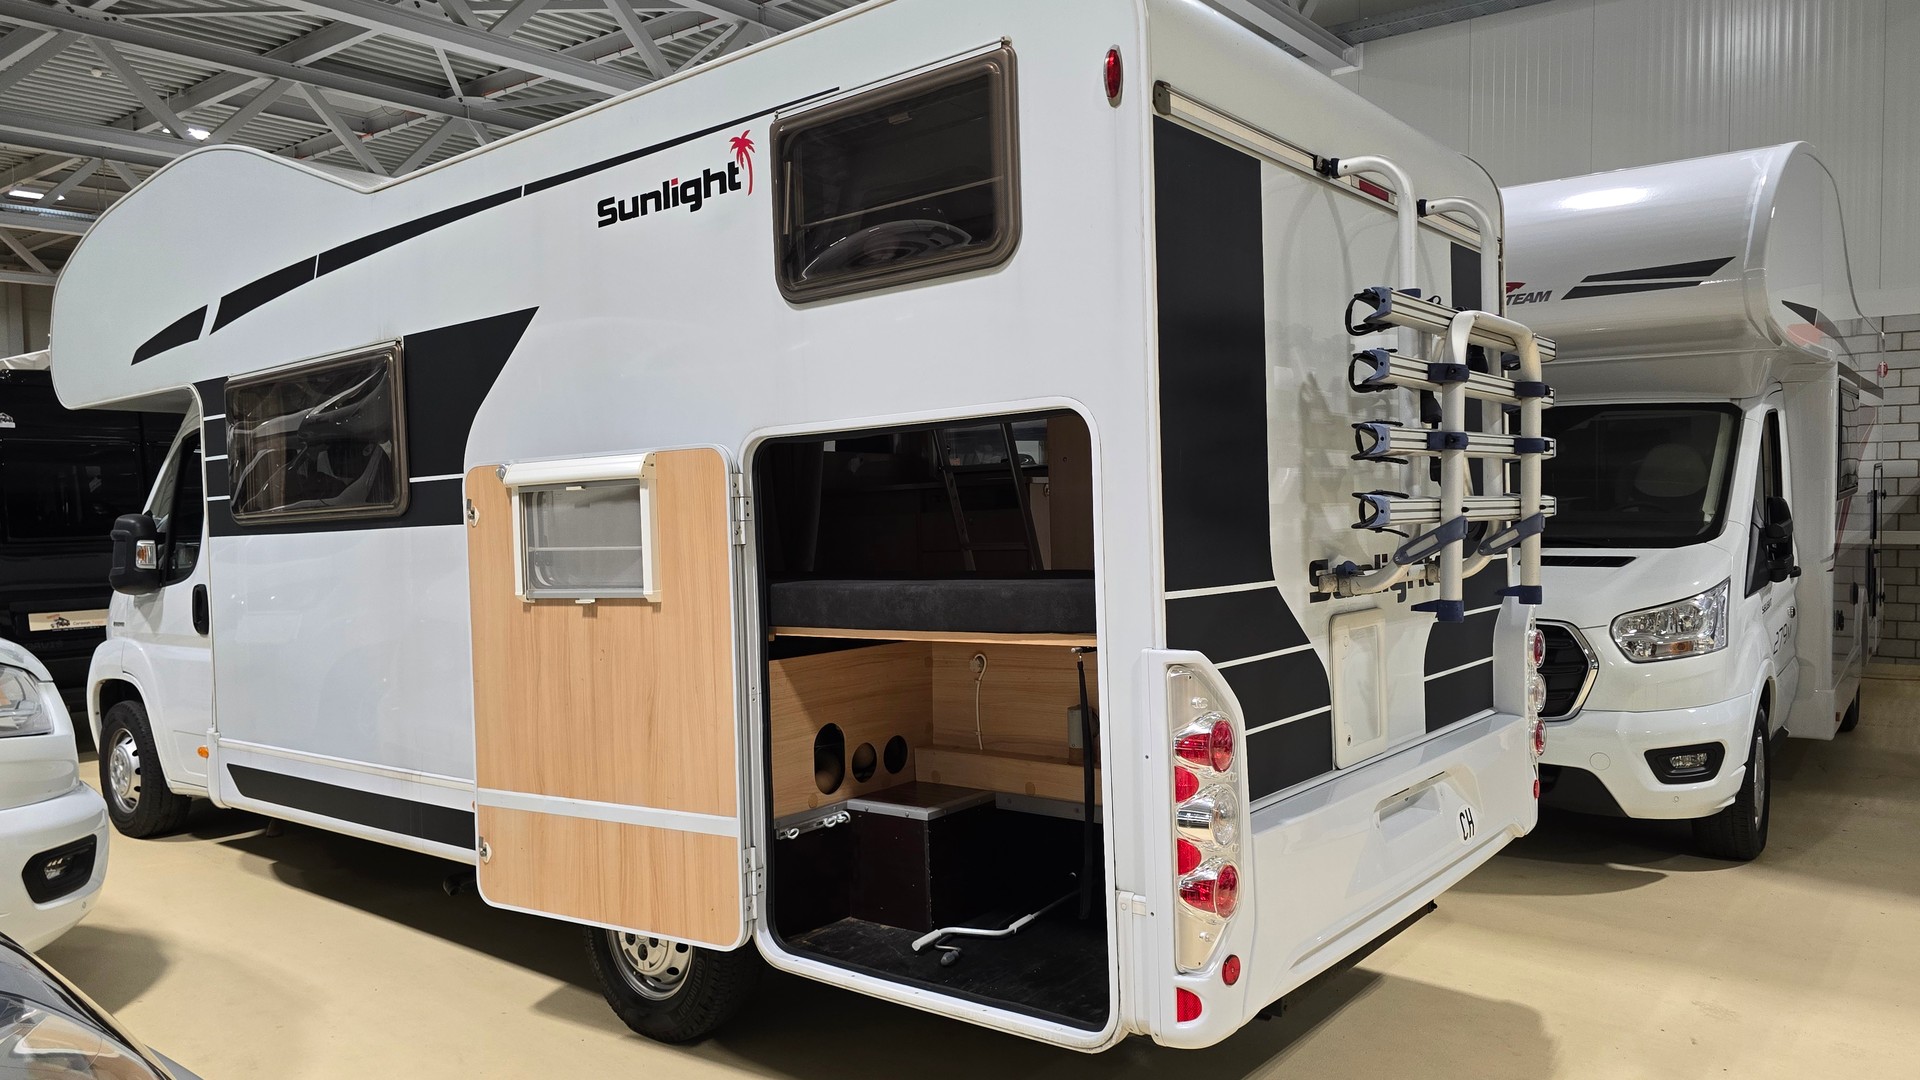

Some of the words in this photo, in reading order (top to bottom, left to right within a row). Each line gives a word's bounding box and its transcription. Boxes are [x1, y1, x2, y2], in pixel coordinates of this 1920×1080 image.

[597, 161, 742, 229] Sunlight
[1506, 290, 1553, 306] TEAM
[1459, 807, 1475, 842] CH
